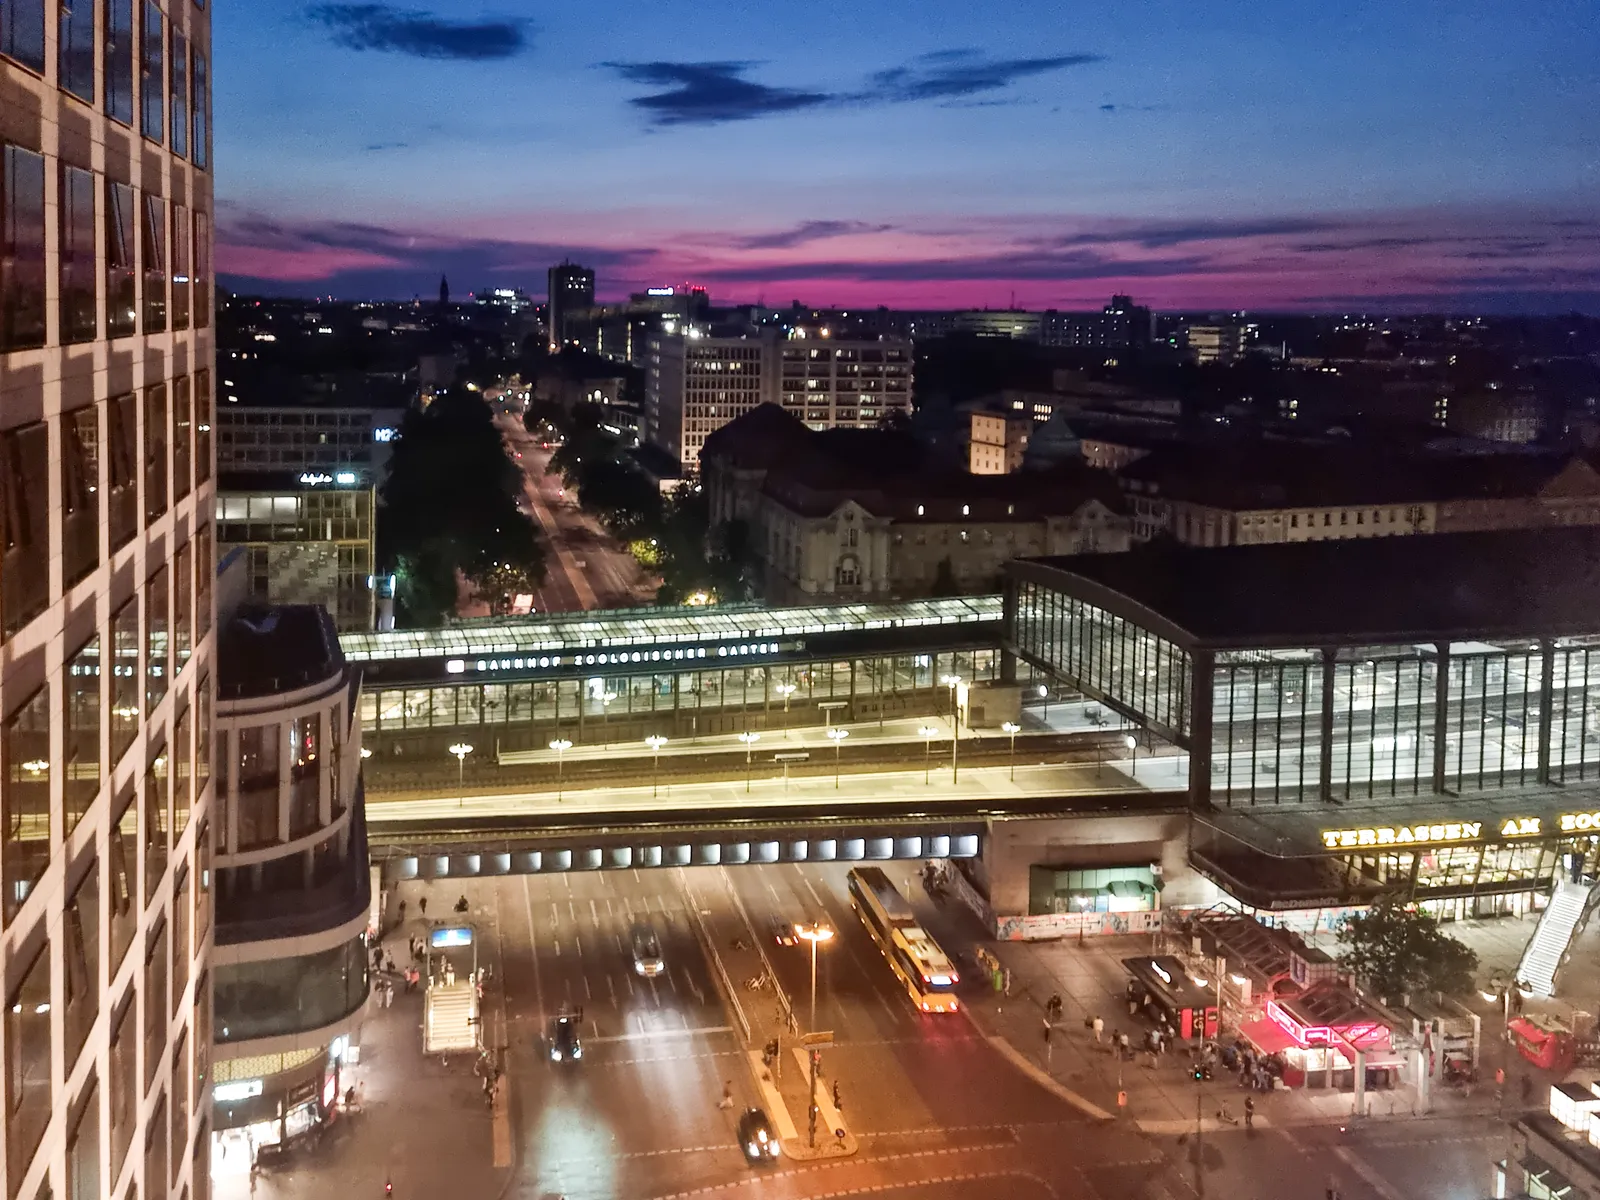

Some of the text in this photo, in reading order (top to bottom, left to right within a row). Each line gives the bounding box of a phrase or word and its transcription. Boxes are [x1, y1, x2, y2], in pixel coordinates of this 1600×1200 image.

[477, 643, 779, 671] BAHNHOF ZOOLOGISCHER GARTEN
[1323, 823, 1482, 847] TERRASSEN
[1501, 817, 1541, 836] AM
